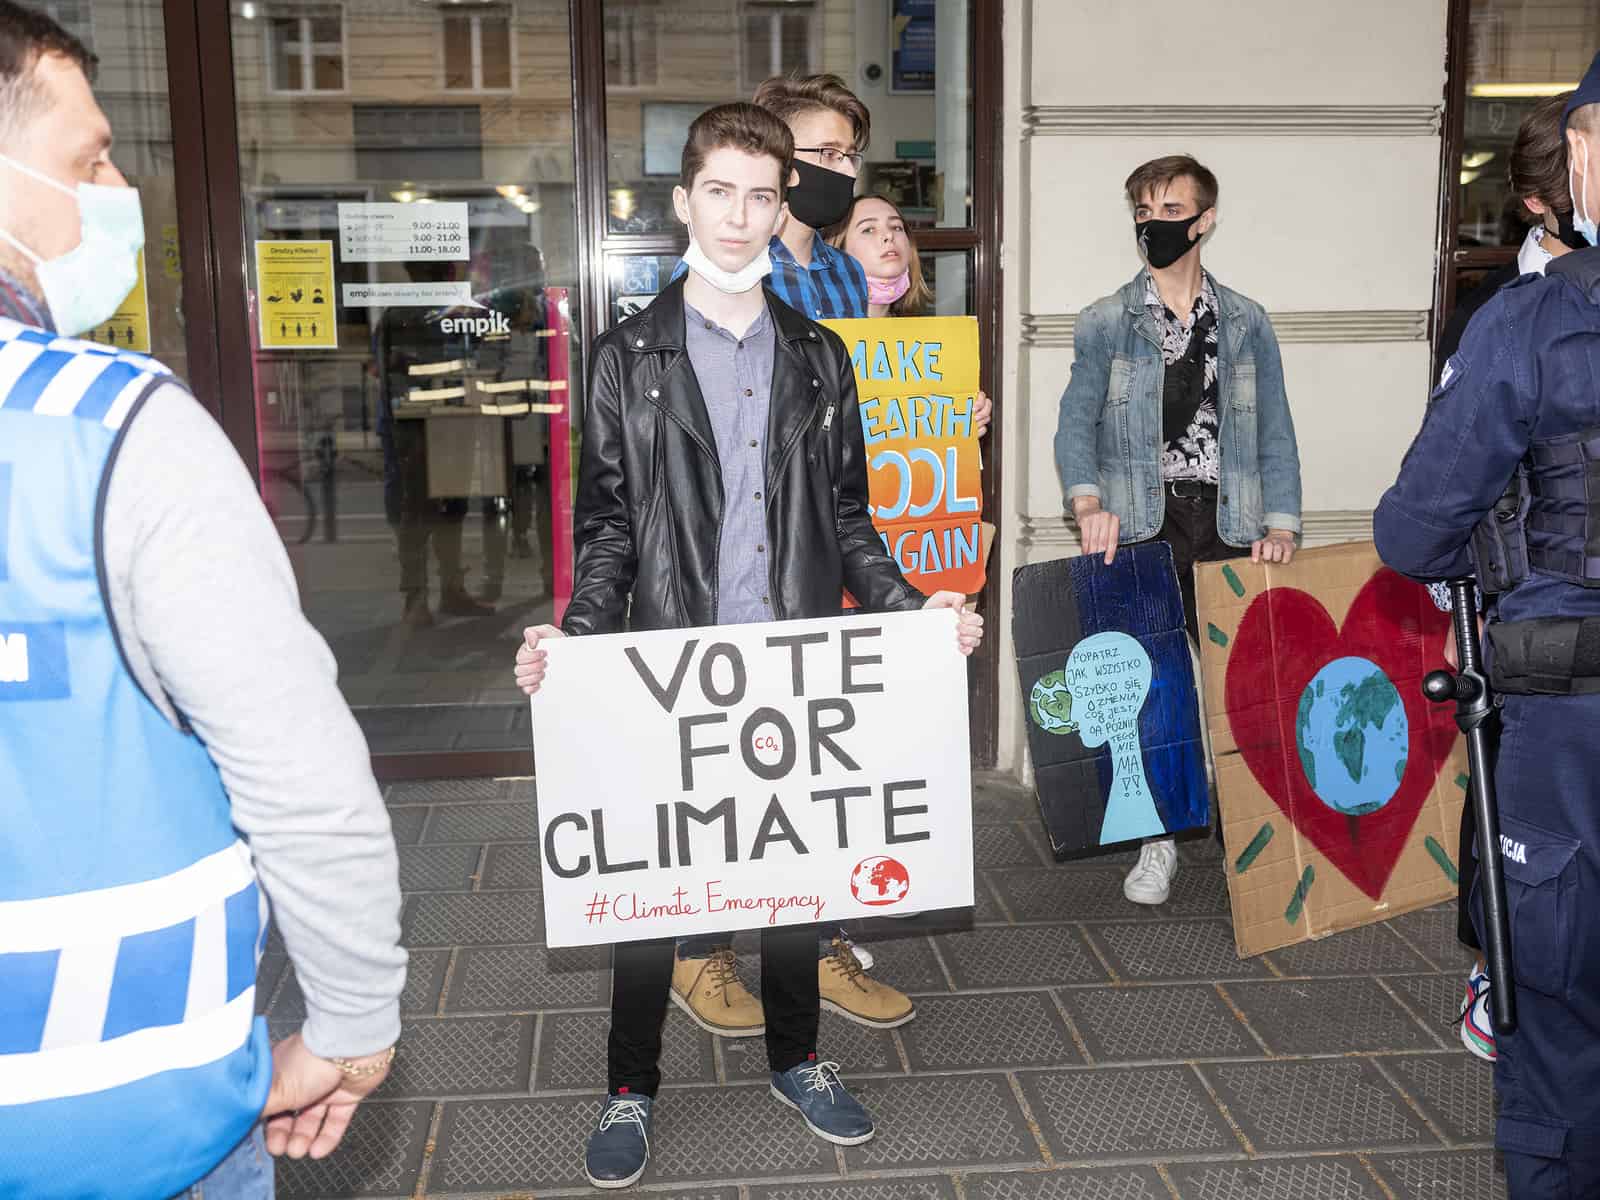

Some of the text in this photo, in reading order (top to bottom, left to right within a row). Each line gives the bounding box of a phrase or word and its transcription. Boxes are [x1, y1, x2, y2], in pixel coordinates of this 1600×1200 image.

[440, 310, 511, 337] empik
[858, 394, 974, 446] EARTH
[624, 626, 884, 713] VOTE
[1072, 648, 1120, 664] POPATRZ
[1067, 667, 1088, 686] JAK
[1074, 682, 1118, 698] SZYBKO
[678, 697, 861, 792] FOR
[1117, 741, 1136, 752] NIE
[1116, 754, 1139, 776] MA
[544, 779, 931, 879] CLIMATE
[585, 879, 826, 924] #Climate Emergency
